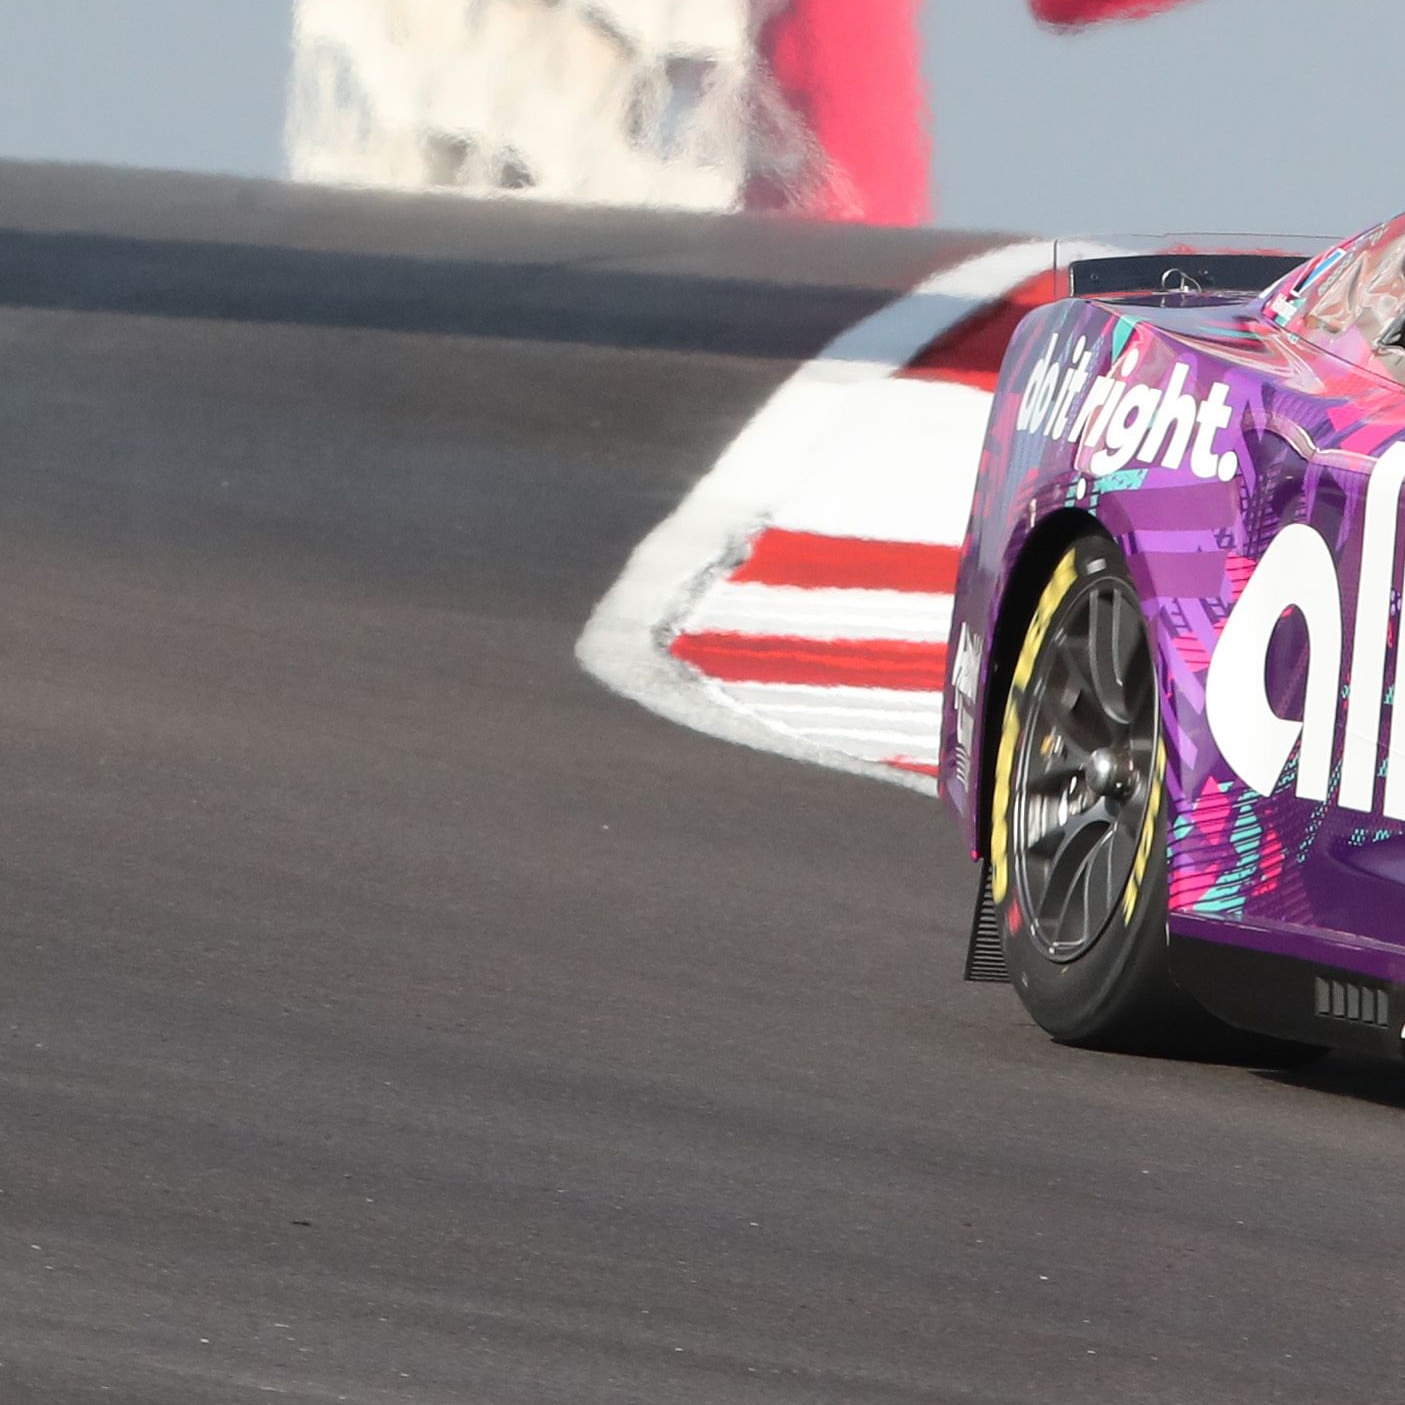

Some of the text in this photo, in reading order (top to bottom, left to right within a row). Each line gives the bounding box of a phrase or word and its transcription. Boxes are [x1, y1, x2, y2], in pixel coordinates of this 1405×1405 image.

[1016, 332, 1238, 483] do it right.
